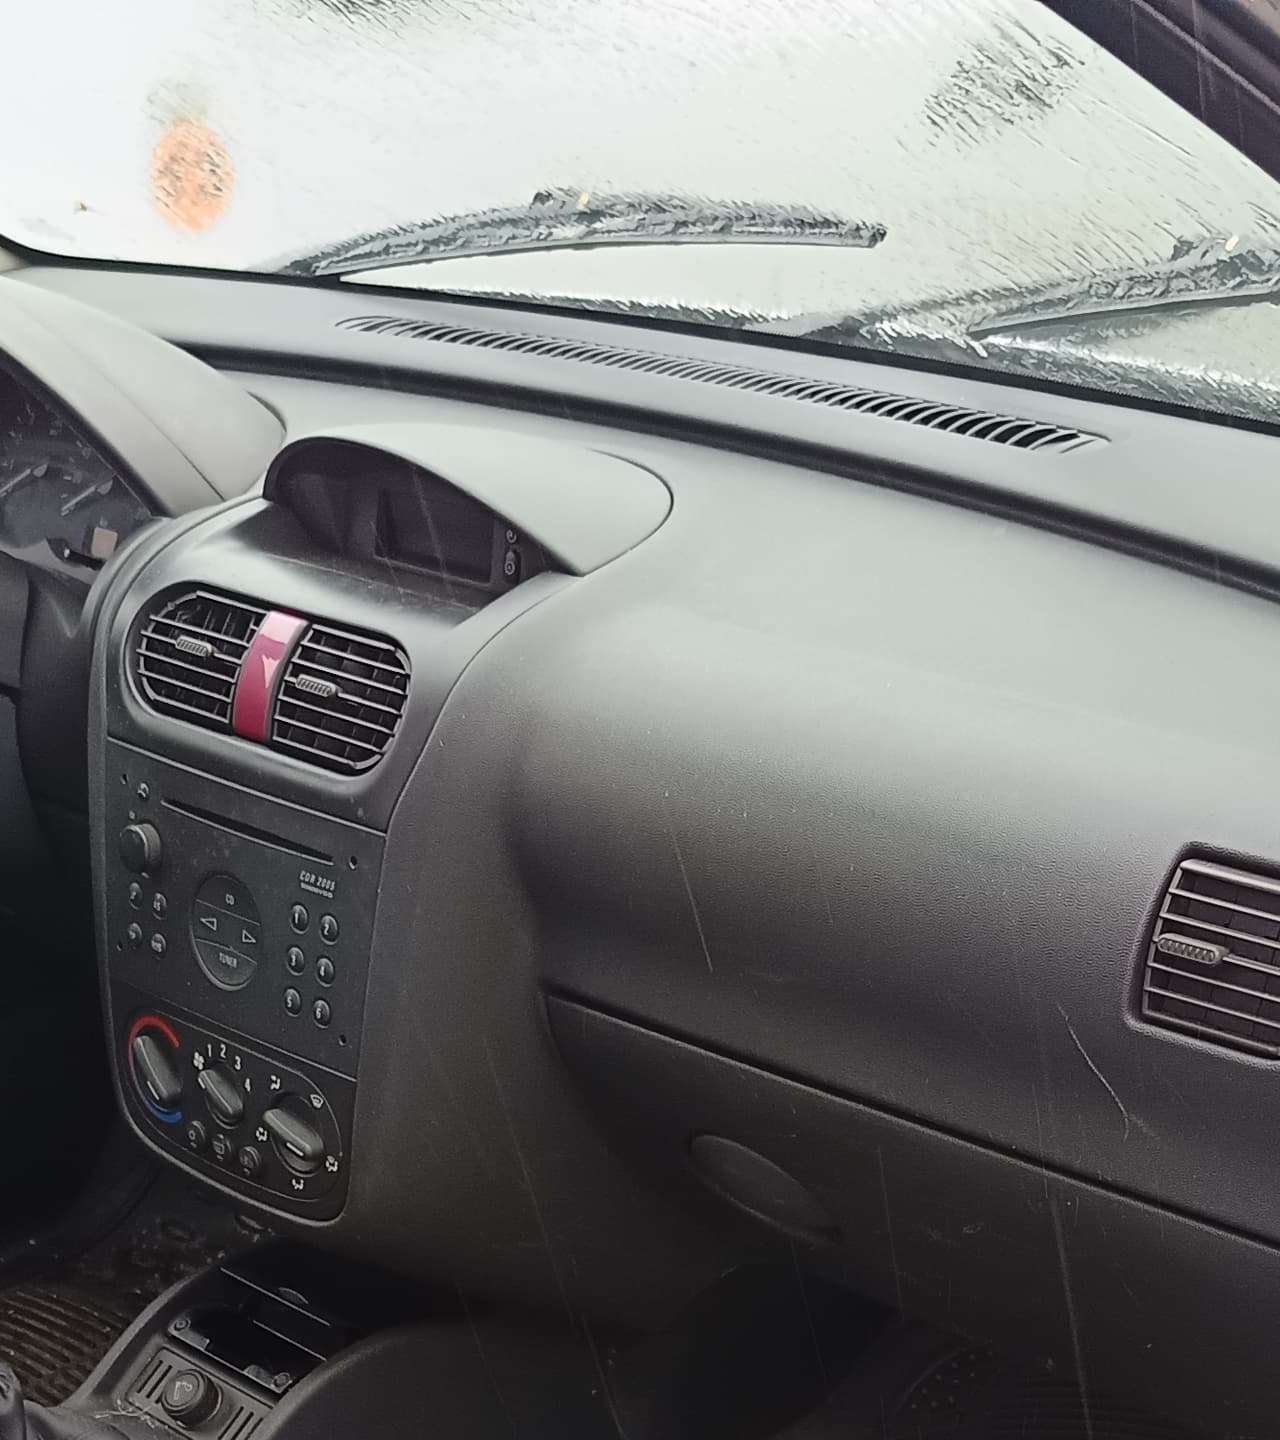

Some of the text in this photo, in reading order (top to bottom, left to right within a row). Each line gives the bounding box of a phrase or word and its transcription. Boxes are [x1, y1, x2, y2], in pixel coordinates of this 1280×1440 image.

[220, 1043, 227, 1059] 2
[234, 1055, 242, 1071] 3
[244, 1077, 252, 1093] 4
